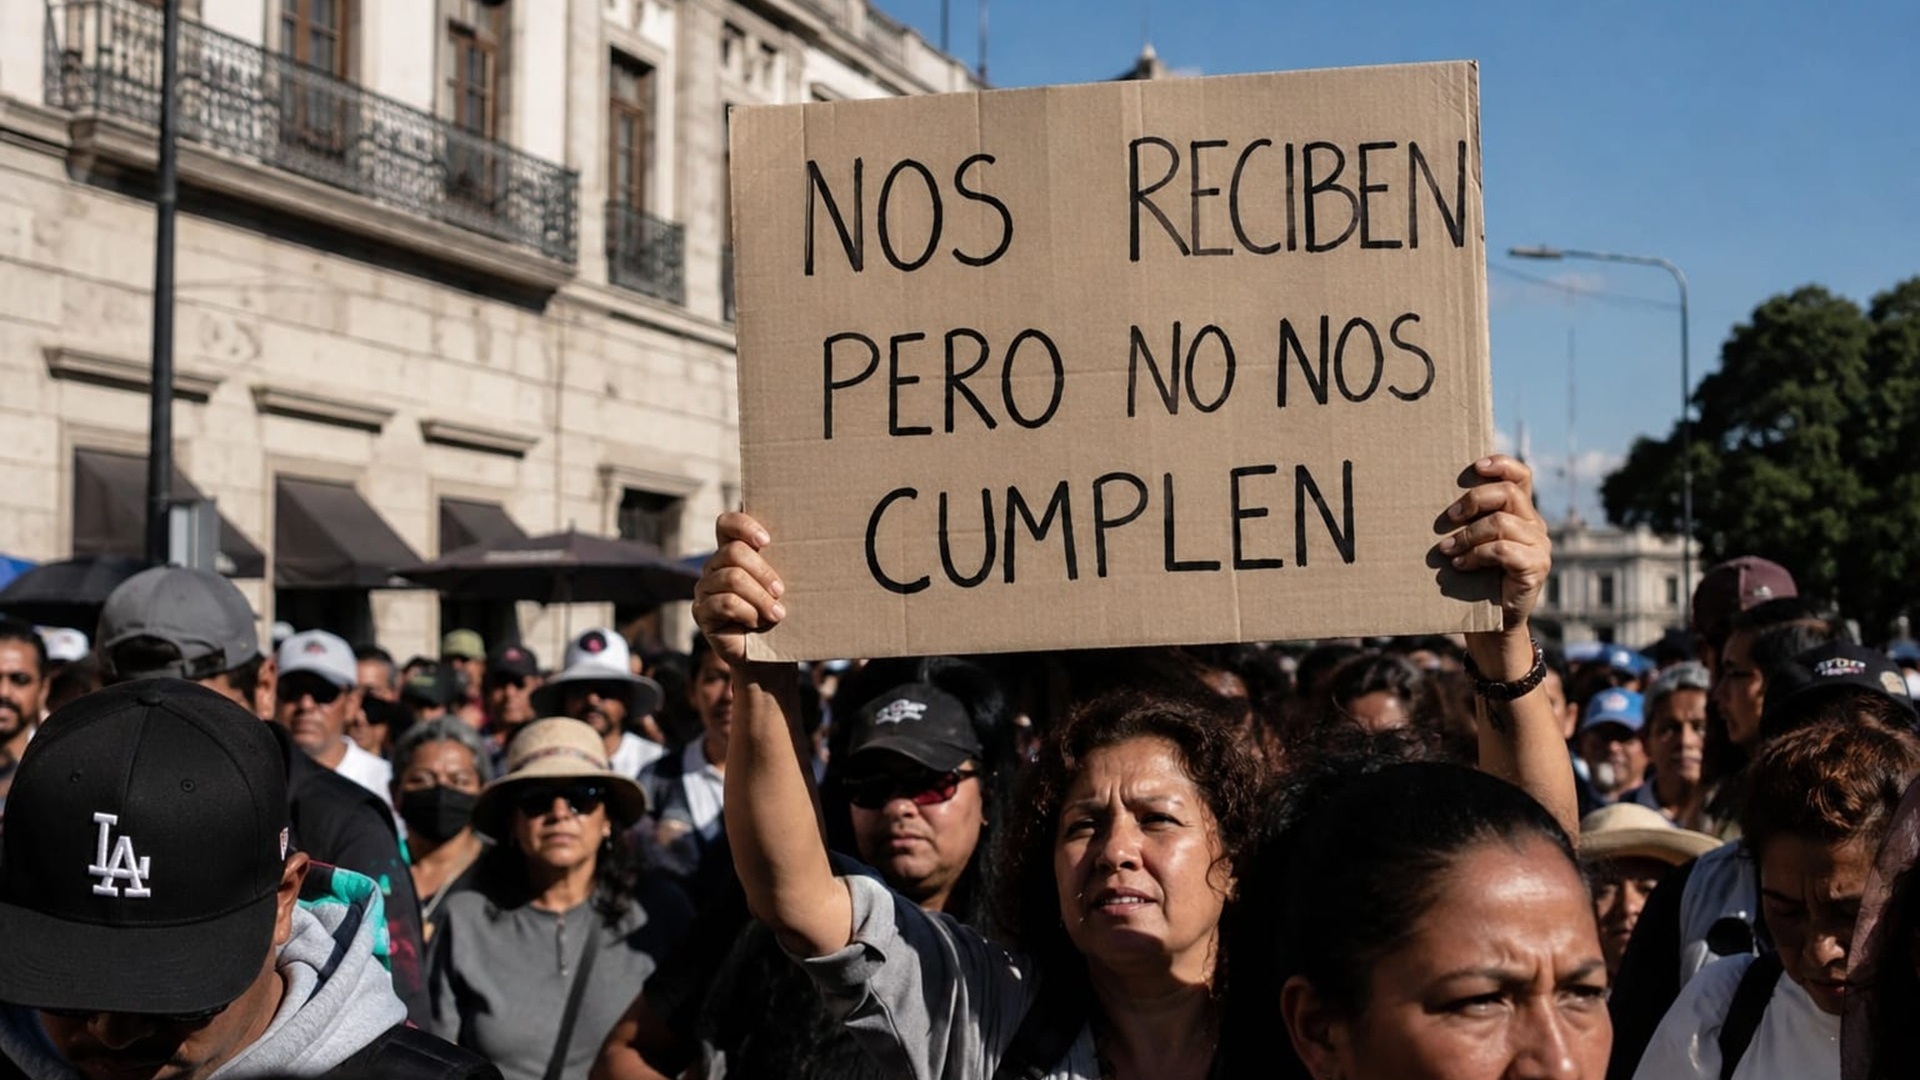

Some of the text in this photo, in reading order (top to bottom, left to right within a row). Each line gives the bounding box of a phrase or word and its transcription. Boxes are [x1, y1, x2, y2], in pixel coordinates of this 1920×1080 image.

[804, 137, 1467, 276] NOS RECIBEN
[823, 313, 1435, 440] PERO NO NOS
[865, 459, 1356, 596] CUMPLEN
[88, 811, 151, 898] LA
